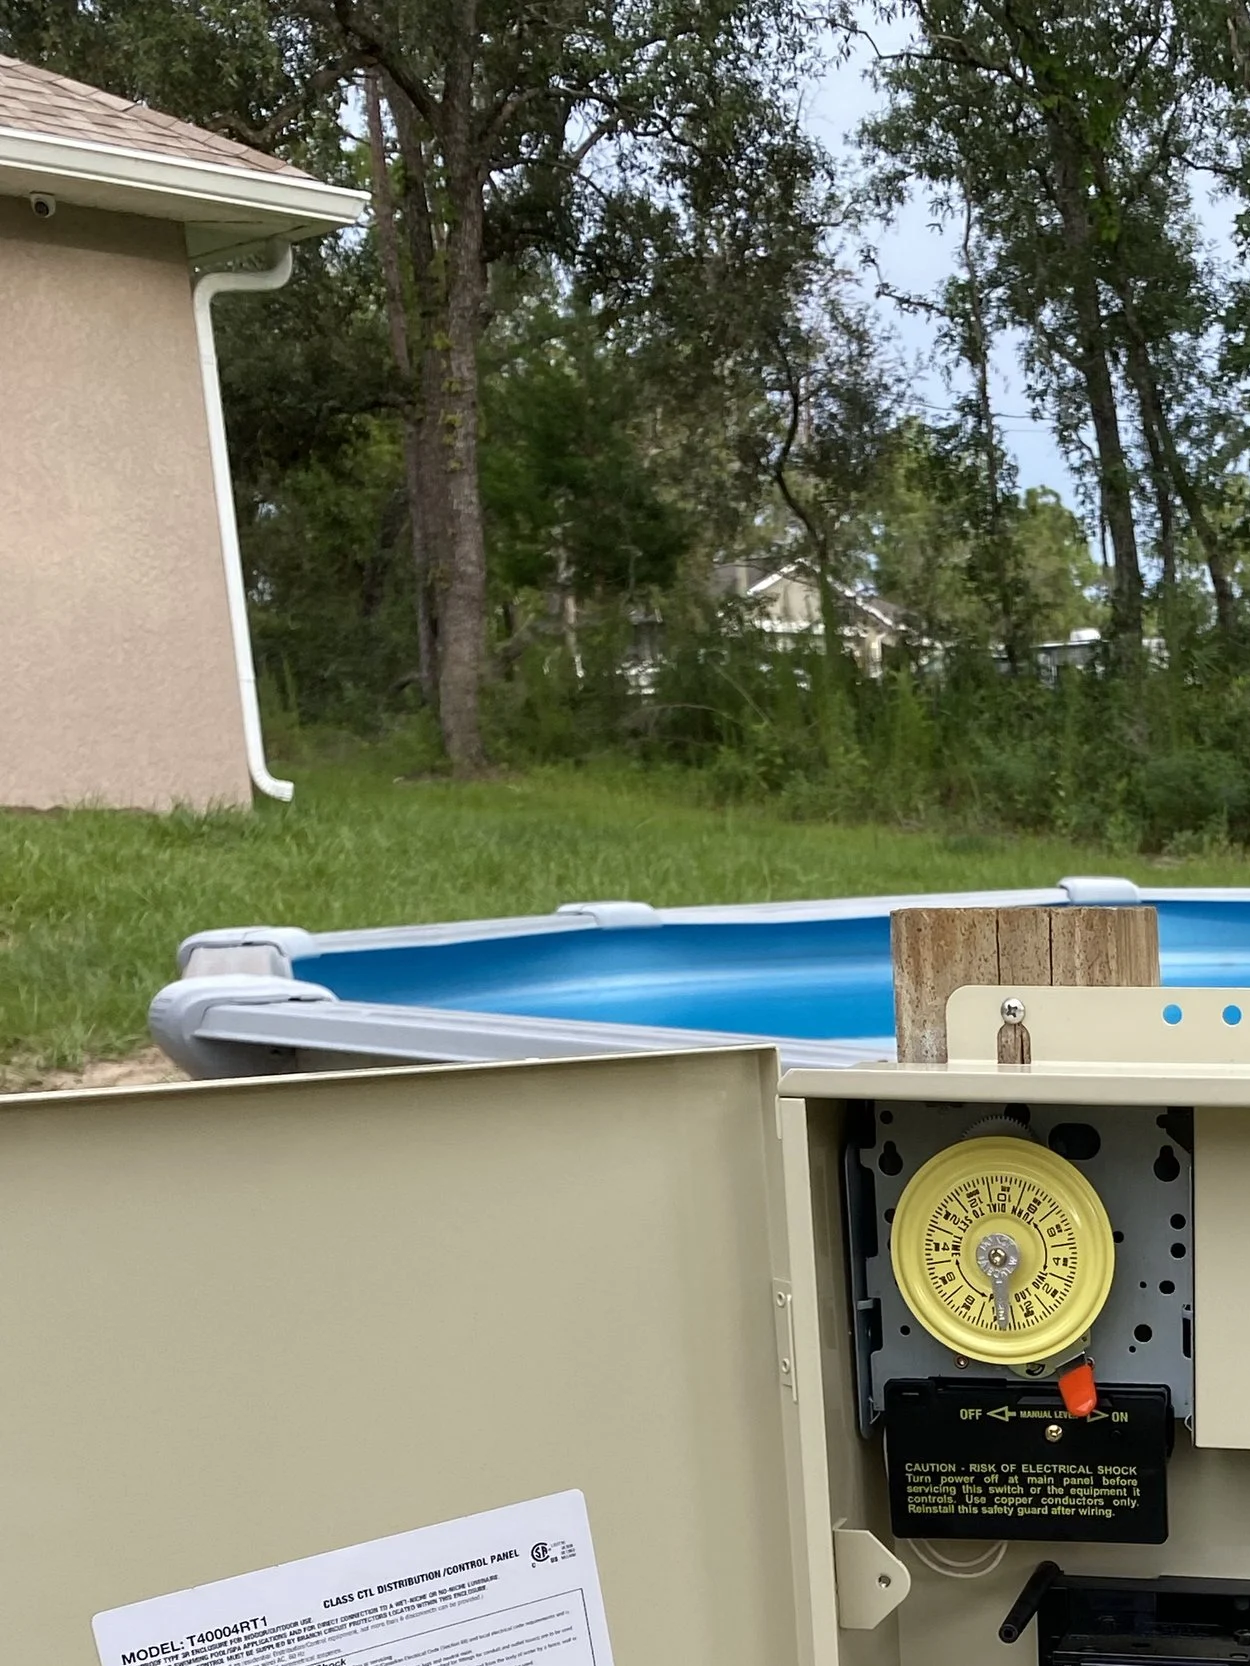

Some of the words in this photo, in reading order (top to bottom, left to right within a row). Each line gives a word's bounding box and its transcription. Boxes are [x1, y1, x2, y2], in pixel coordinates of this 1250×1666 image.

[974, 1207, 985, 1219] TO
[987, 1203, 1006, 1213] DIAL
[1011, 1206, 1034, 1225] TURN
[958, 1217, 972, 1233] SET
[951, 1235, 963, 1257] TIME
[960, 1409, 982, 1420] OFF
[1020, 1410, 1052, 1418] MANUAL
[1111, 1412, 1128, 1422] ON
[905, 1463, 956, 1473] CAUTION
[969, 1464, 996, 1473] RISK
[1001, 1464, 1016, 1473] OF
[1022, 1464, 1093, 1475] ELECTRICAL
[1097, 1465, 1137, 1475] SHOCK
[907, 1474, 931, 1484] Turn
[941, 1475, 975, 1487] power
[984, 1474, 999, 1484] off
[1008, 1475, 1018, 1484] at
[1027, 1475, 1054, 1485] main
[1063, 1476, 1093, 1487] panel
[1103, 1476, 1138, 1486] before
[907, 1485, 956, 1496] servicing
[962, 1485, 982, 1494] this
[989, 1485, 1023, 1495] switch
[1030, 1486, 1041, 1495] or
[1048, 1485, 1064, 1495] the
[1070, 1486, 1133, 1499] equipment
[908, 1495, 957, 1504] controls.
[965, 1495, 986, 1504] Use
[994, 1496, 1032, 1507] copper
[1041, 1496, 1104, 1506] conductors
[1113, 1497, 1139, 1508] only.
[908, 1504, 955, 1514] Reinstall
[958, 1505, 978, 1514] this
[981, 1505, 1013, 1516] safety
[1017, 1506, 1048, 1518] guard
[1051, 1506, 1076, 1516] after
[1079, 1507, 1115, 1518] wiring.
[323, 1593, 354, 1609] CLASS
[356, 1587, 375, 1600] CTL
[376, 1569, 441, 1594] DISTRIBUTION
[489, 1548, 519, 1564] PANEL
[121, 1638, 184, 1665] MODEL:
[186, 1615, 267, 1647] T40004RT1
